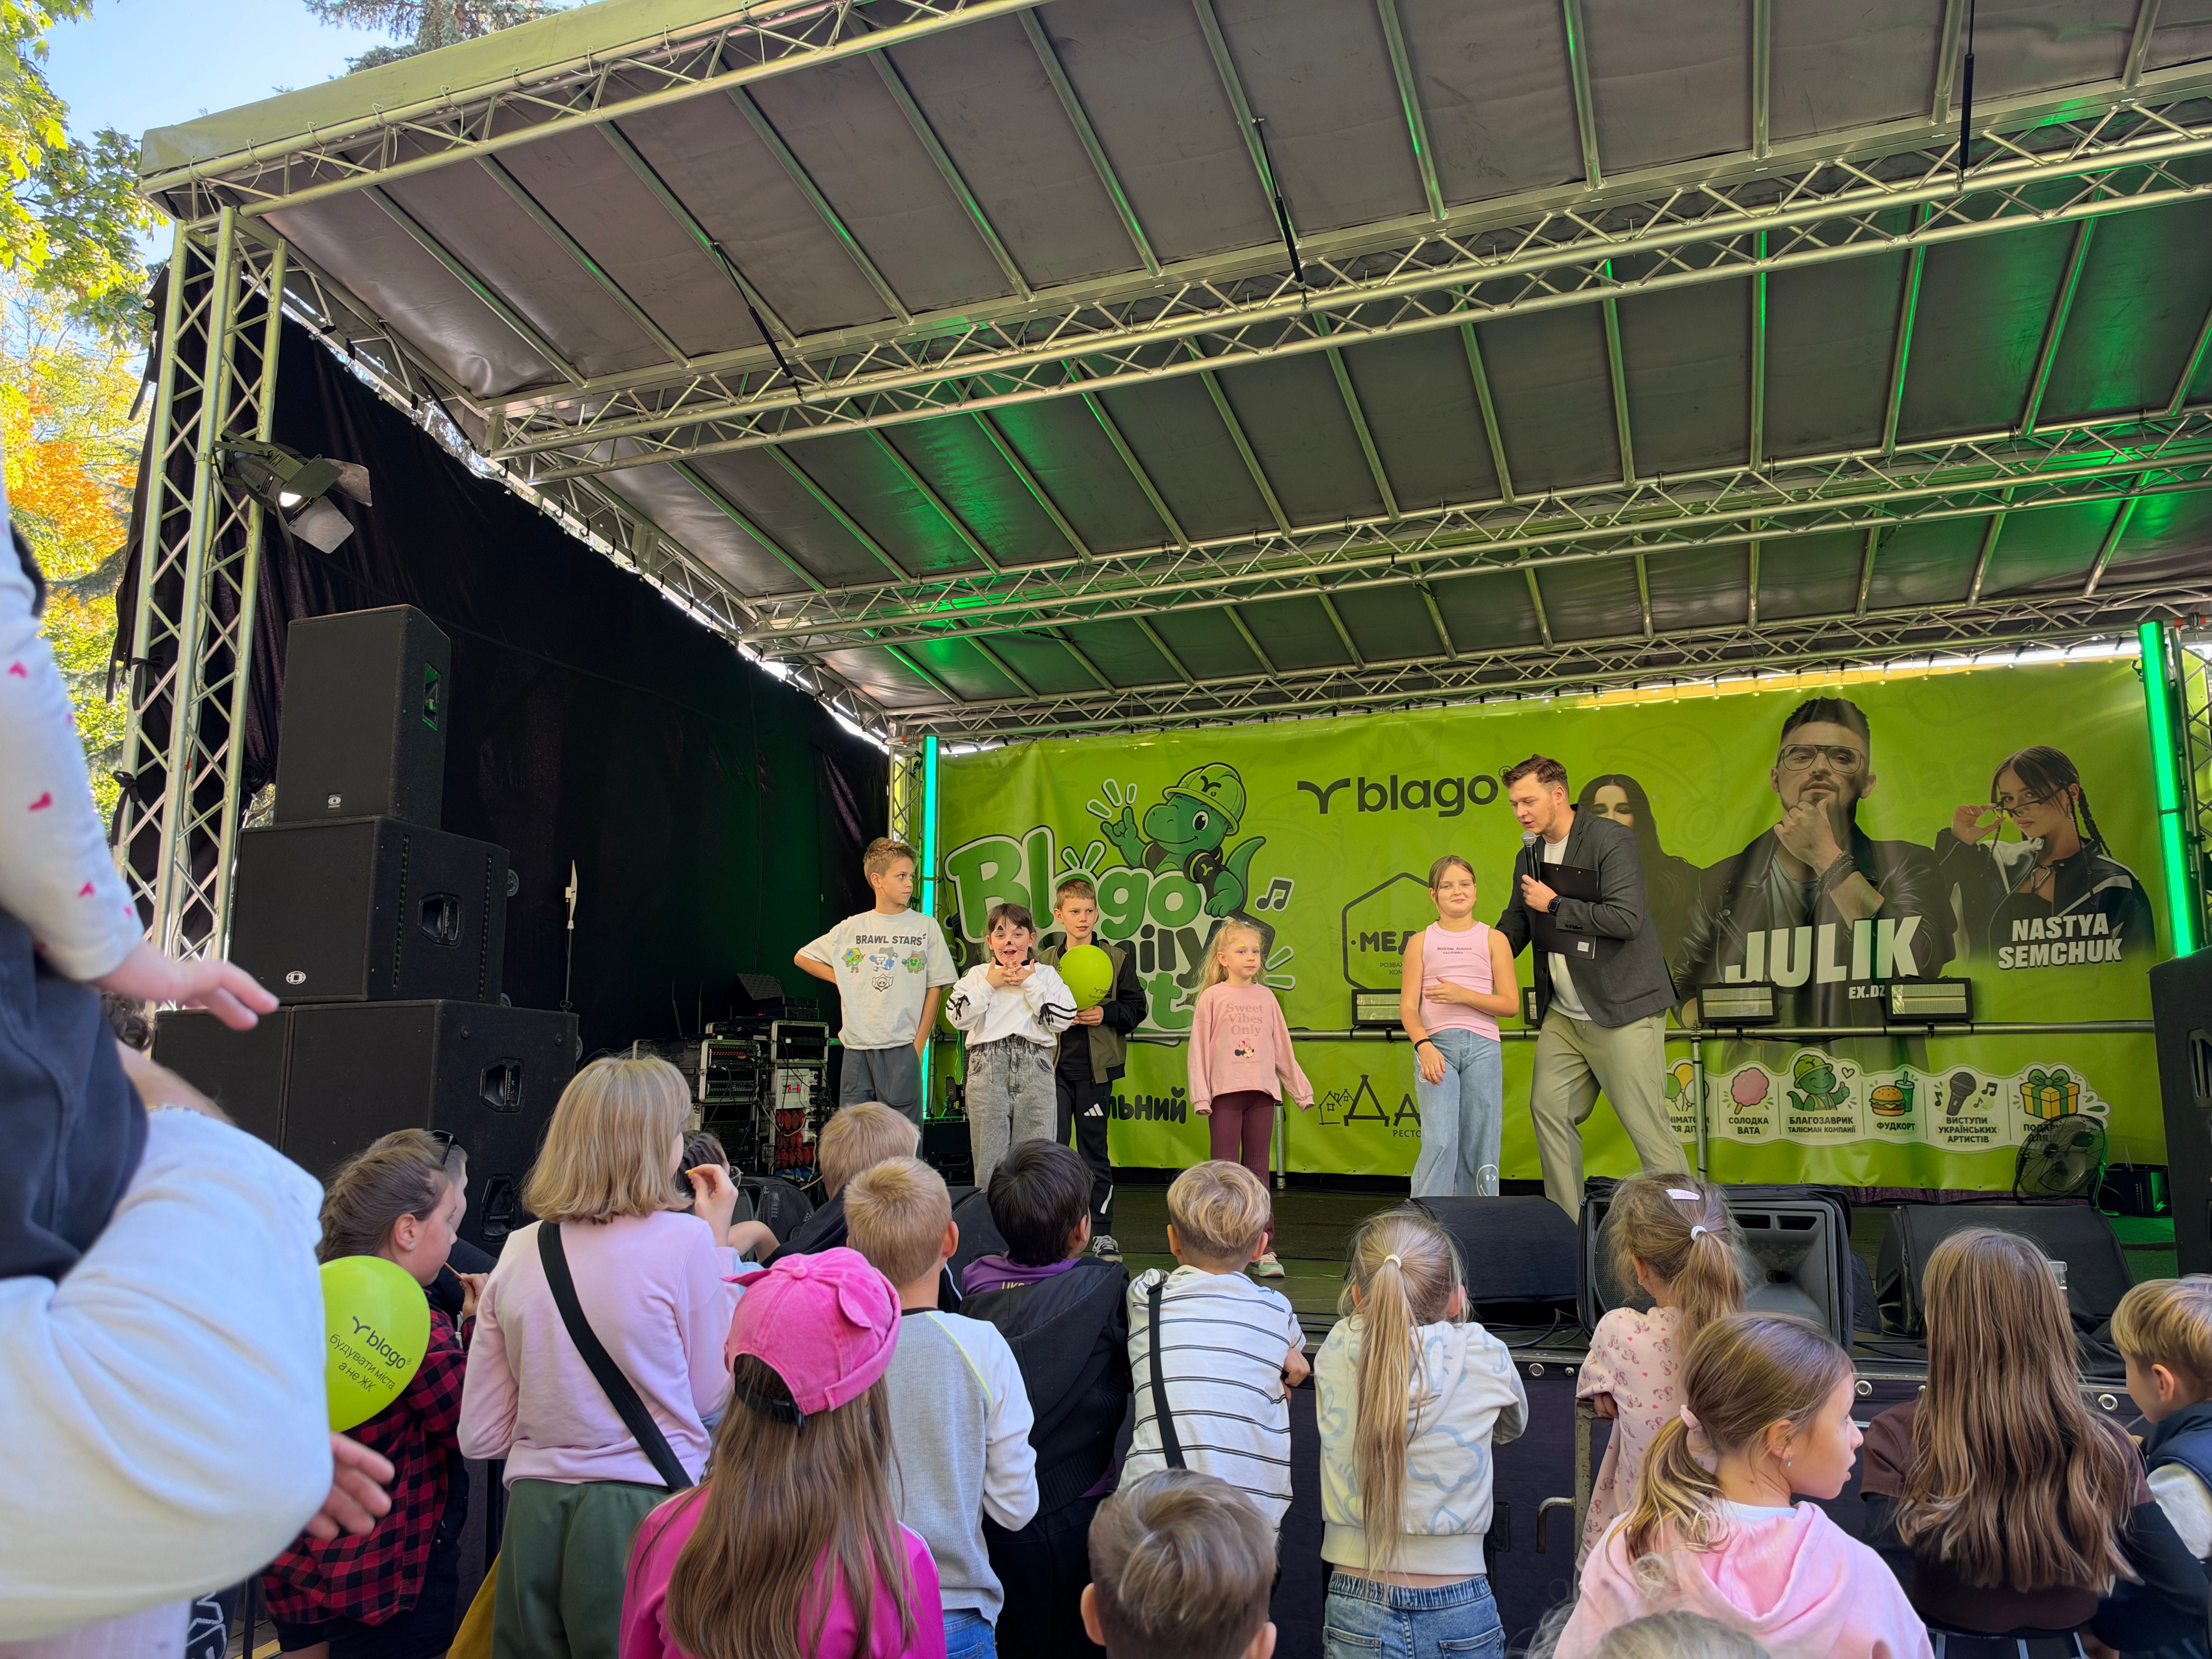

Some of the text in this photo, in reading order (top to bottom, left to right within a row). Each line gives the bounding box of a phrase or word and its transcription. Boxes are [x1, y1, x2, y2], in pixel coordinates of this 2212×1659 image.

[2012, 912, 2109, 942] NASTYA
[856, 935, 922, 946] BRAWL STARS
[1725, 915, 1922, 988] JULIK
[1998, 938, 2123, 970] SEMCHUK
[1226, 1003, 1264, 1013] Sweet
[1228, 1013, 1262, 1024] Vibes
[1231, 1024, 1261, 1036] Only
[1728, 1117, 1769, 1125] СОЛОДКА
[1789, 1116, 1853, 1125] БЛАГОЗАВРИК
[1876, 1121, 1915, 1131] ФУДКОРТ
[1737, 1127, 1760, 1135] ВАТА
[1938, 1125, 1997, 1133] УКРАЇНСЬКИХ
[330, 1334, 376, 1374] будувати
[366, 1330, 406, 1369] blago
[338, 1362, 377, 1393] а не ЖК
